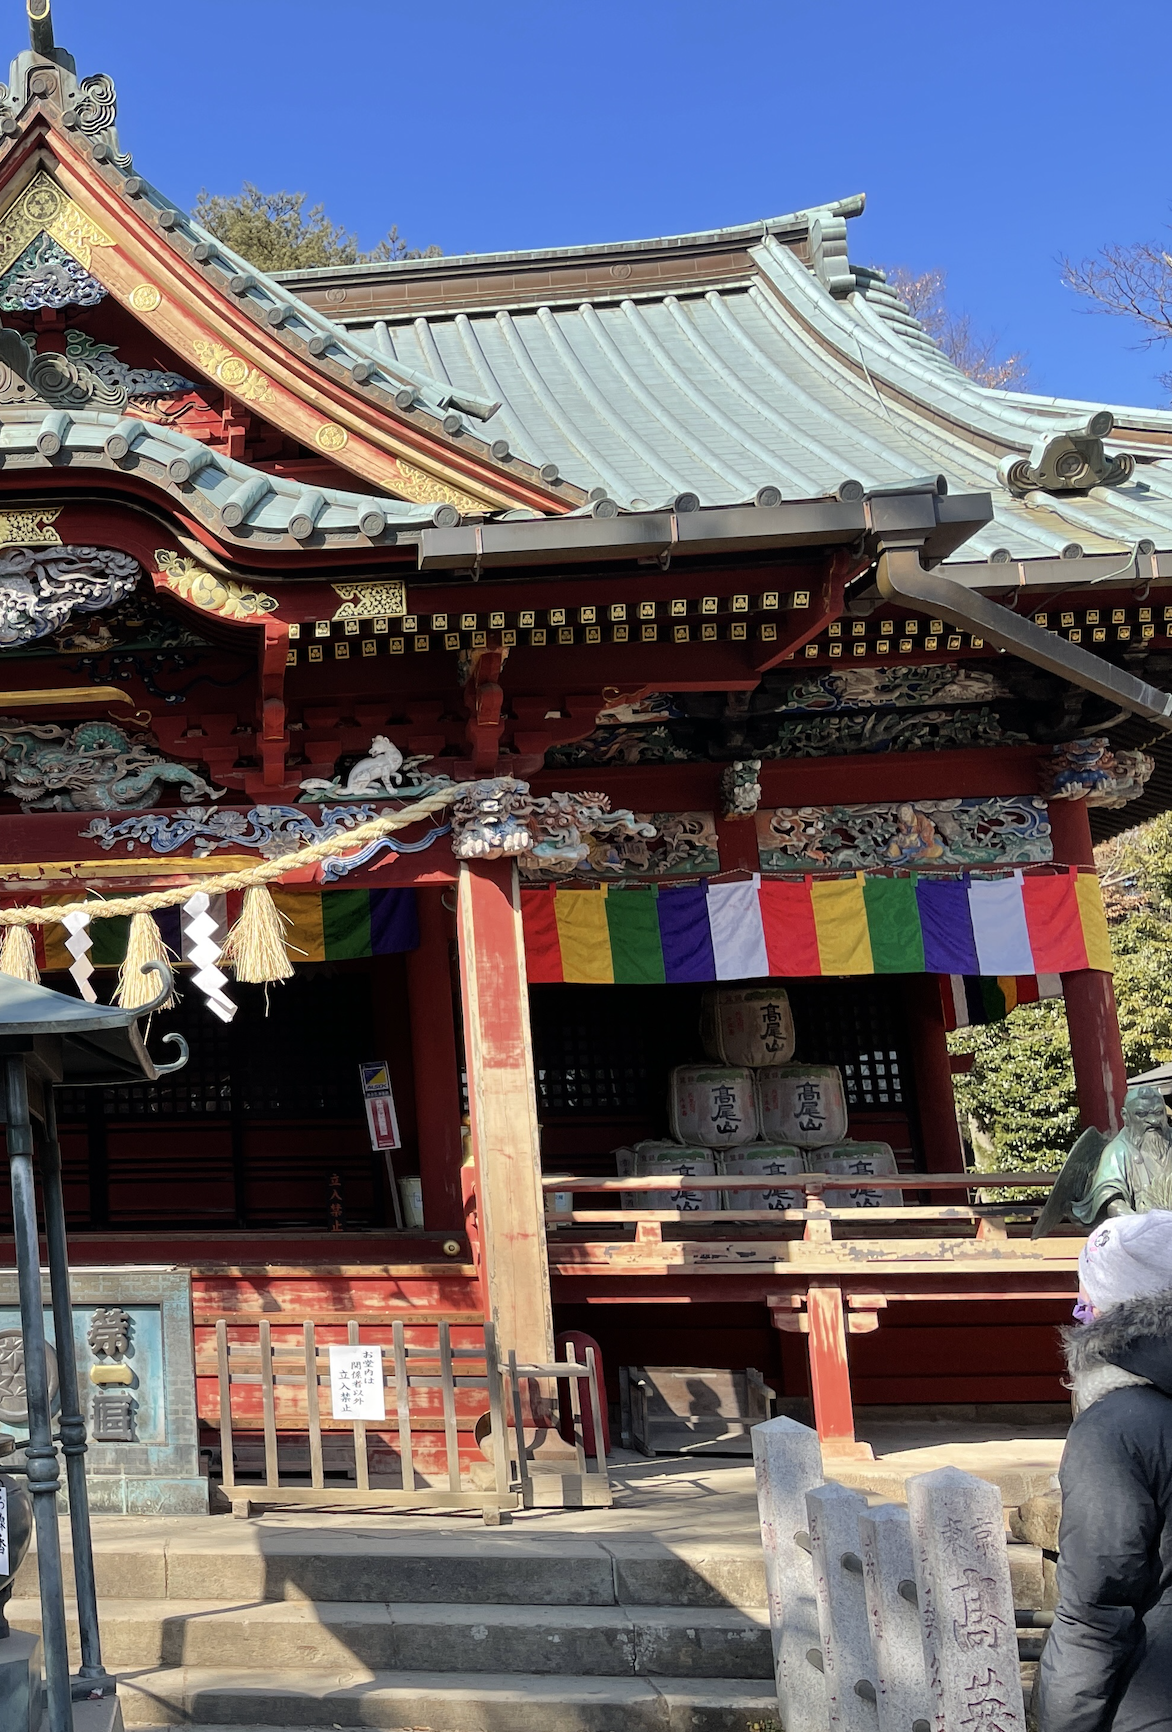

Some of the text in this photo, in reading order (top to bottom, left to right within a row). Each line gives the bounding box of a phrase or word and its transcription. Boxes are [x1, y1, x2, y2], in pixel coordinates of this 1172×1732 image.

[329, 1173, 344, 1232] 立入禁止
[350, 1361, 365, 1405] 関係者以外
[362, 1350, 375, 1385] お堂内は
[338, 1369, 353, 1413] 立入禁止
